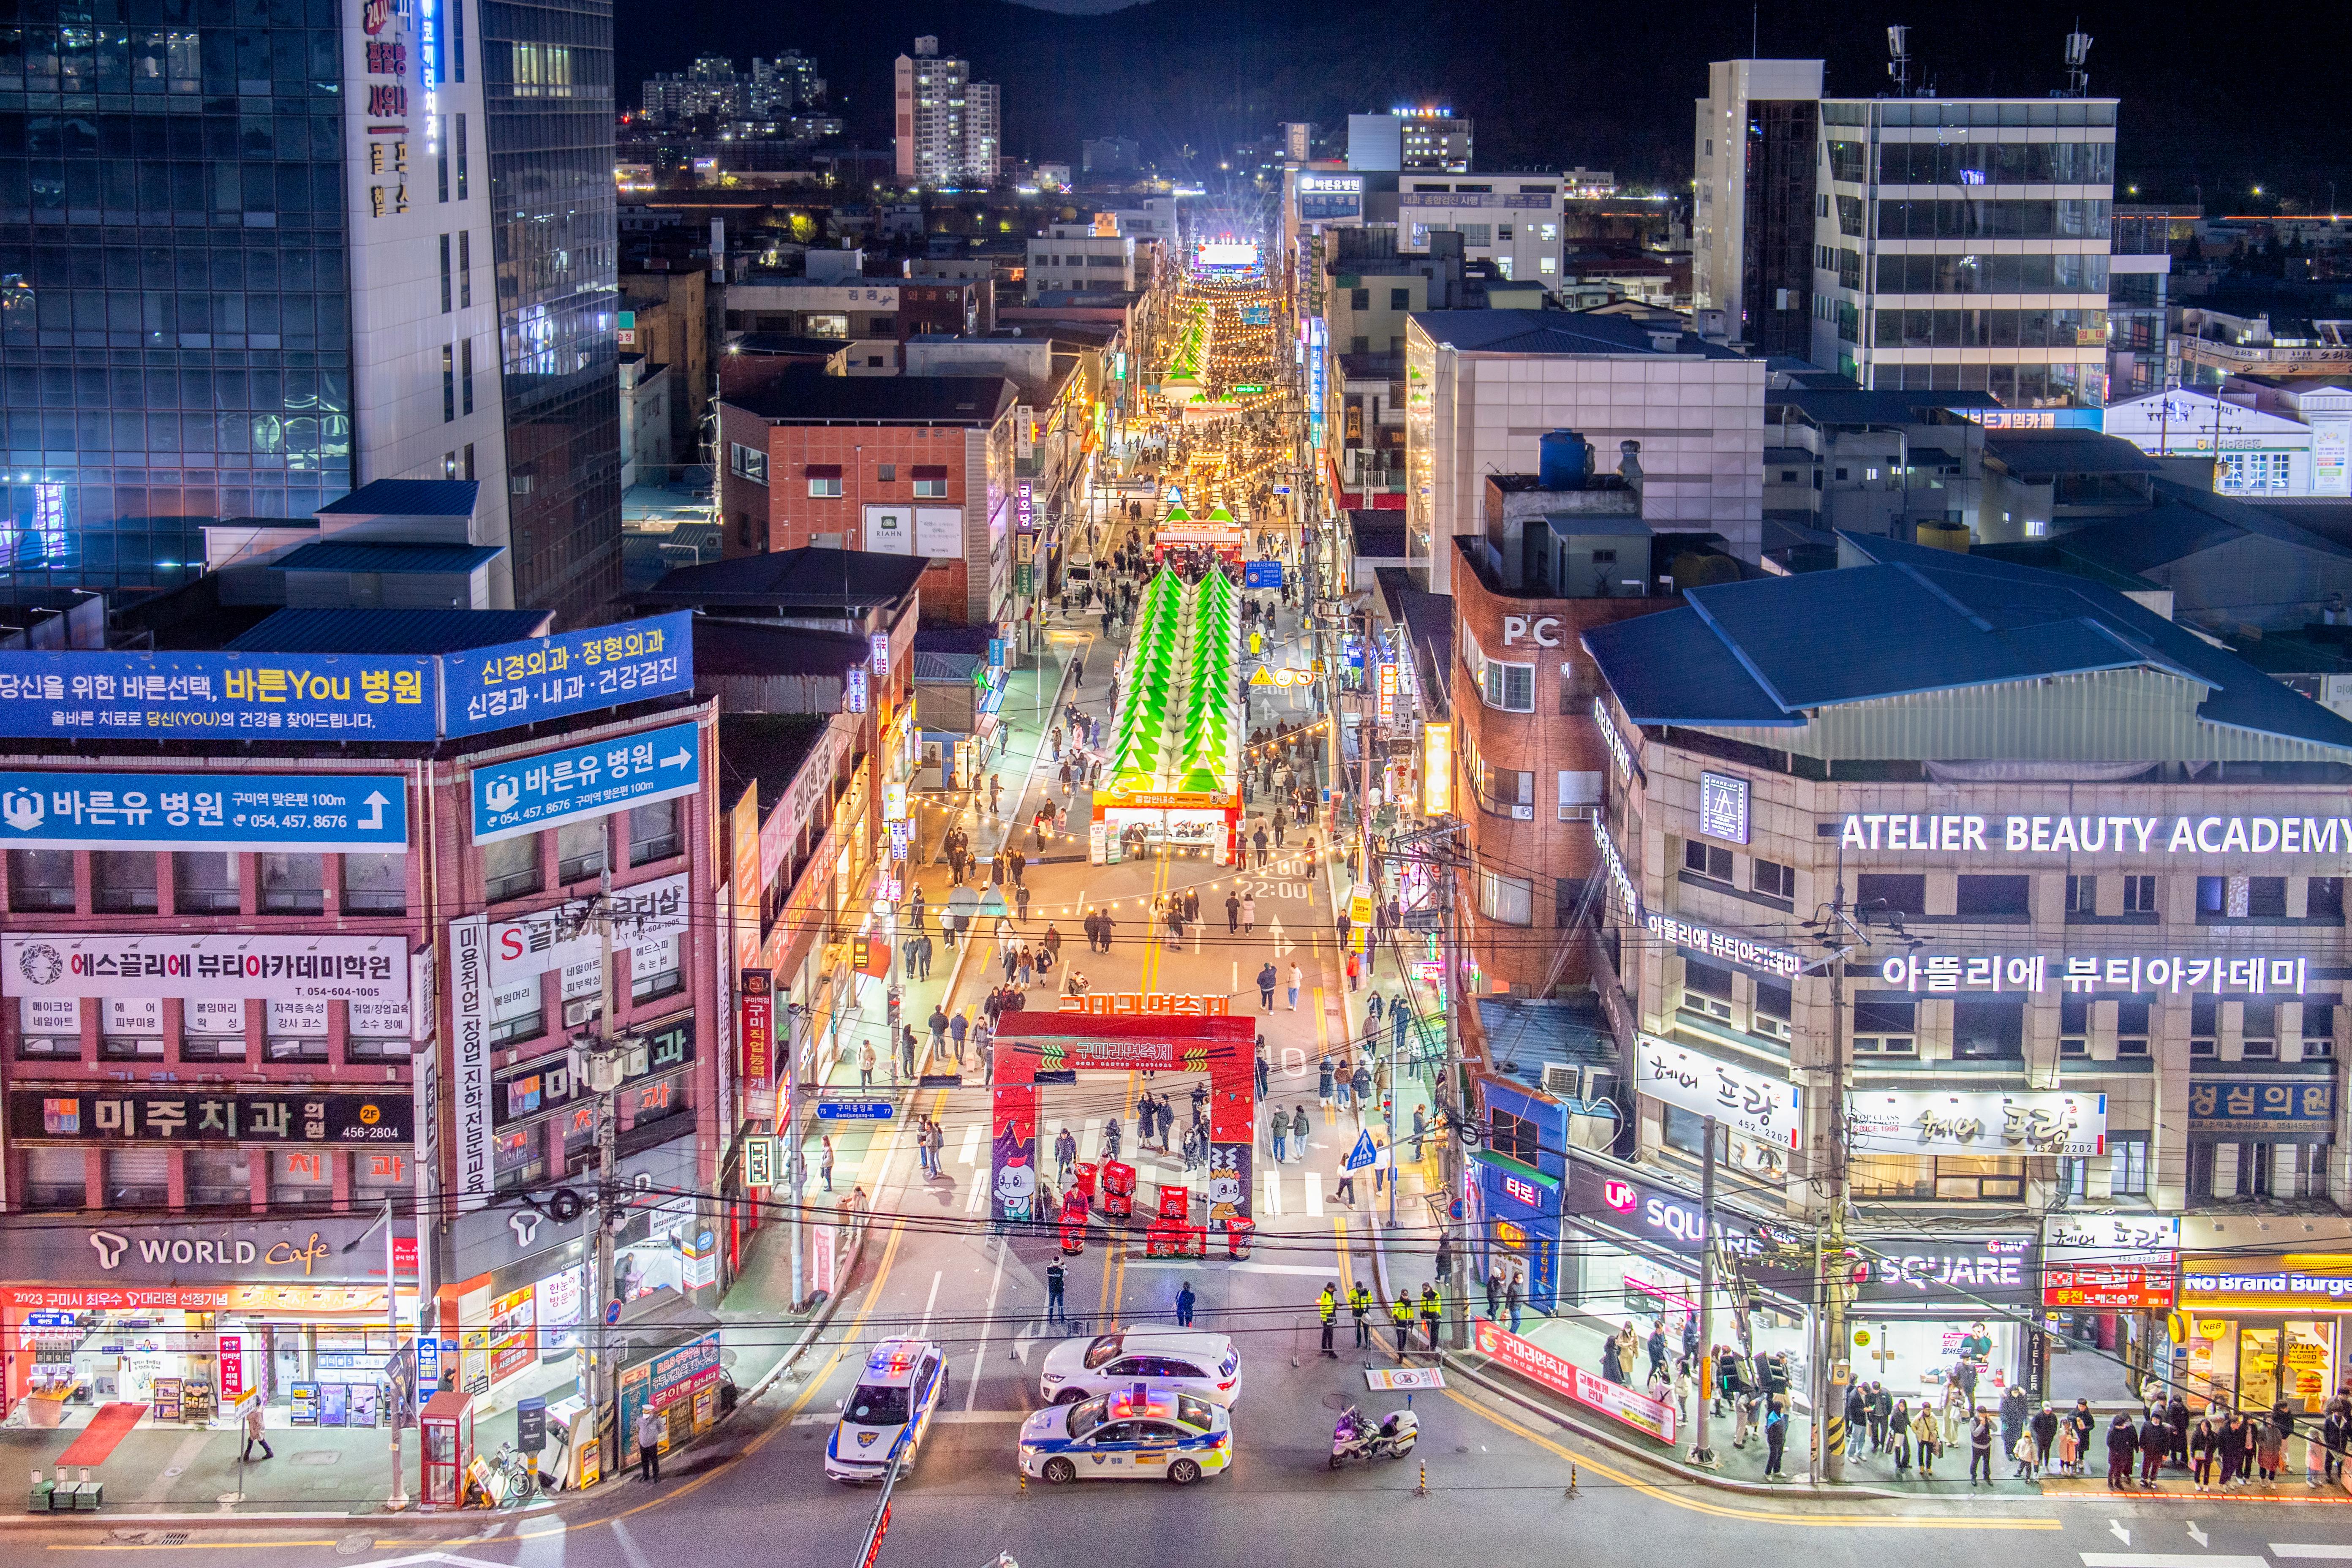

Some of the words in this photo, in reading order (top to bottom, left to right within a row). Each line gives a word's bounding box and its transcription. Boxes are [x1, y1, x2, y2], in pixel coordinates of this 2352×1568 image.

[368, 44, 407, 74] 찜질방
[370, 85, 408, 117] 사우나
[1019, 485, 1031, 527] 금오당
[72, 675, 116, 701] 위한
[123, 675, 218, 703] 바른선택,
[225, 669, 350, 702] 바른You
[361, 670, 422, 705] 병원
[1279, 674, 1288, 682] 40
[52, 711, 94, 727] 올바른
[99, 711, 142, 727] 치료로
[147, 711, 235, 729] 당신(YOU)의
[240, 712, 282, 727] 건강을
[287, 713, 376, 730] 찾아드립니다.
[525, 754, 602, 797] 바른유
[606, 741, 654, 773] 병원
[1710, 779, 1738, 789] MAKE-UP
[232, 793, 269, 807] 구미역
[272, 793, 309, 807] 맞은편
[312, 794, 346, 806] 100m
[574, 791, 602, 808] 구미역
[603, 786, 629, 803] 맞은편
[630, 781, 654, 797] 100m
[53, 790, 152, 827] 바른유
[161, 792, 224, 827] 병원
[1842, 814, 1988, 851] ATELIER
[2005, 816, 2158, 852] BEAUTY
[1240, 881, 1307, 899] 22:00
[636, 939, 669, 957] 헤드스파
[71, 953, 192, 979] 에스끌리에
[198, 953, 392, 980] 뷰티아카데미학원
[566, 959, 601, 977] 네일아트
[1882, 955, 2046, 993] 아뜰리에
[2062, 956, 2306, 996] 뷰티아카데미
[307, 986, 380, 997] 054-604-1005
[32, 1001, 73, 1013] 메이크업
[196, 1002, 237, 1014] 붙임머리
[274, 1002, 325, 1014] 자격증속성
[353, 1003, 410, 1015] 취업/창업교육
[1058, 992, 1230, 1017] 구미라면축제
[33, 1016, 74, 1028] 네일아트
[115, 1017, 156, 1029] 피부미용
[278, 1018, 298, 1029] 강사
[302, 1018, 321, 1029] 코스
[360, 1018, 381, 1030] 소수
[384, 1019, 404, 1031] 정예
[1075, 1042, 1173, 1062] 구미라면축제
[837, 1104, 874, 1112] 구미중앙로
[2189, 1086, 2332, 1116] 성심의원
[95, 1099, 293, 1138] 미주치과
[362, 1108, 378, 1120] 2F
[343, 1126, 399, 1139] 456-2804
[1506, 1176, 1535, 1206] 타로
[700, 1237, 710, 1246] ADT
[139, 1239, 257, 1265] WORLD
[2158, 1254, 2168, 1262] 2F
[561, 1257, 582, 1270] COFFEE
[1879, 1255, 2022, 1290] SQUARE
[549, 1274, 576, 1295] 한눈에
[2185, 1275, 2217, 1290] No
[2219, 1274, 2287, 1291] Brand
[14, 1293, 43, 1305] 2023
[46, 1293, 82, 1306] 구미시
[86, 1293, 122, 1306] 최우수
[180, 1293, 228, 1306] 선정기념
[2202, 1323, 2221, 1331] NBB
[1502, 1334, 1570, 1380] 구미라면축제
[655, 1377, 692, 1406] 금이빨
[694, 1371, 717, 1388] 삽니다
[1579, 1372, 1609, 1396] 교통통제
[1588, 1388, 1604, 1405] 안내
